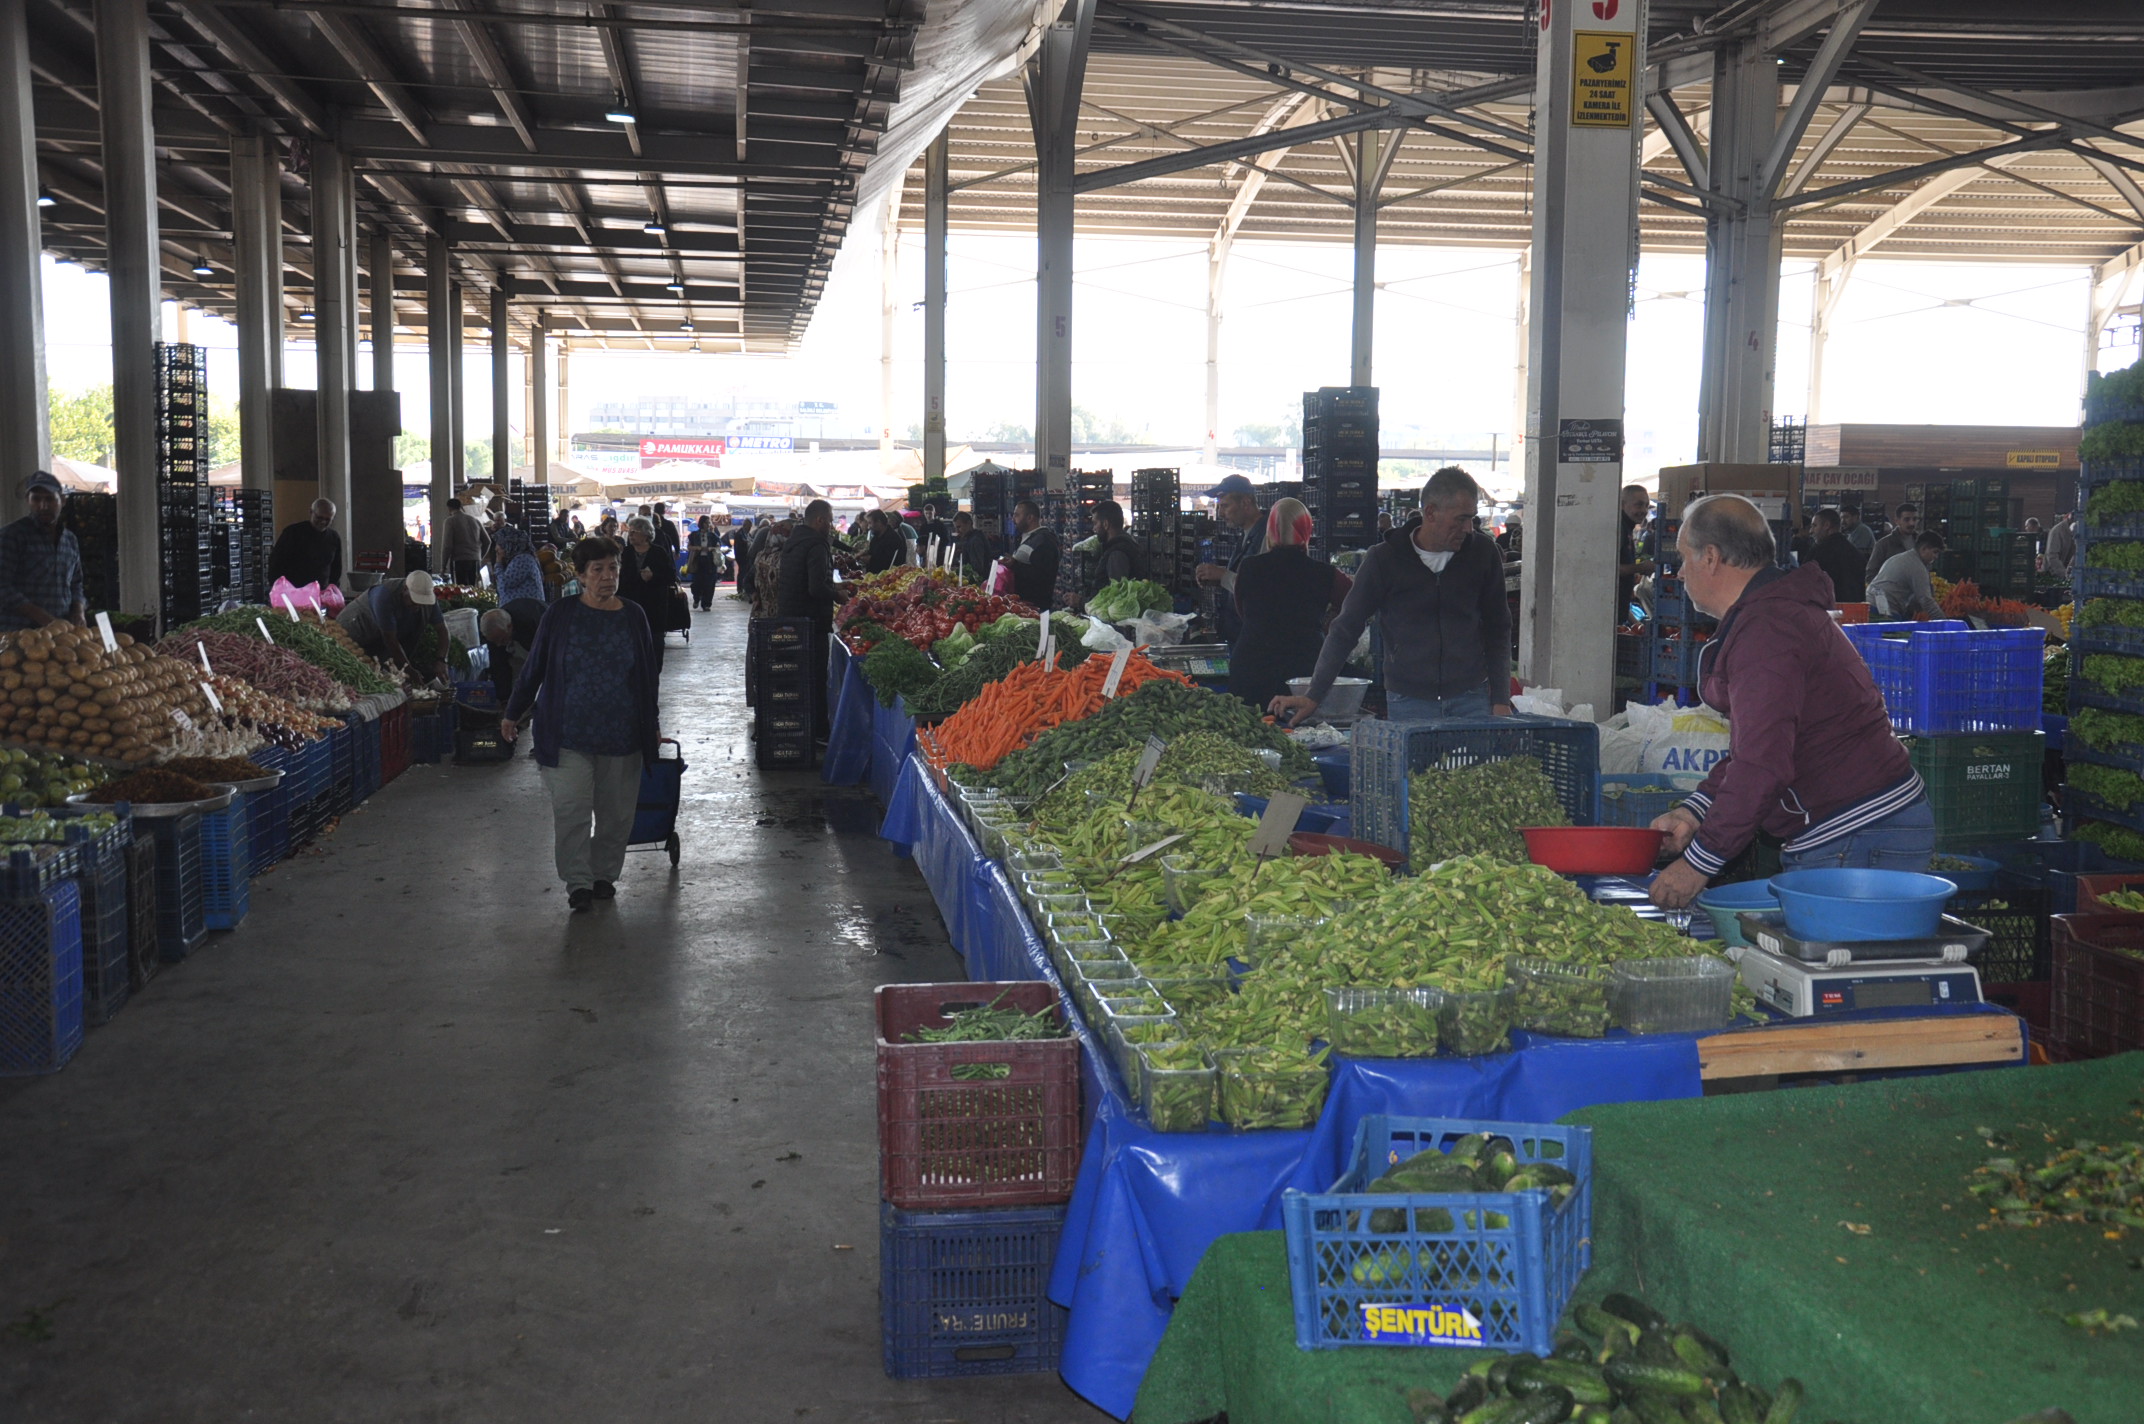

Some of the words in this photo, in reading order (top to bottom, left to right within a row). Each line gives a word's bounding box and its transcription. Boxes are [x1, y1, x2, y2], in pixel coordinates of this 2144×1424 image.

[1580, 78, 1626, 88] PAZARYERİMİZ
[1589, 90, 1598, 98] 24
[1599, 90, 1616, 99] SAAT
[1583, 101, 1610, 109] KAMERA
[1612, 100, 1621, 110] İLE
[1577, 110, 1626, 121] İZLENMEKTEDİR
[1055, 315, 1066, 337] 5
[1762, 409, 1769, 423] 3
[741, 437, 791, 448] METRO
[657, 444, 722, 455] PAMUKKALE
[1823, 472, 1842, 486] ÇAY
[1844, 471, 1875, 485] OCAĞI
[628, 483, 667, 495] UYGUN
[670, 480, 733, 493] BALIKÇILIK
[1967, 764, 2010, 775] BERTAN
[1365, 1305, 1482, 1339] ŞENTÜRK
